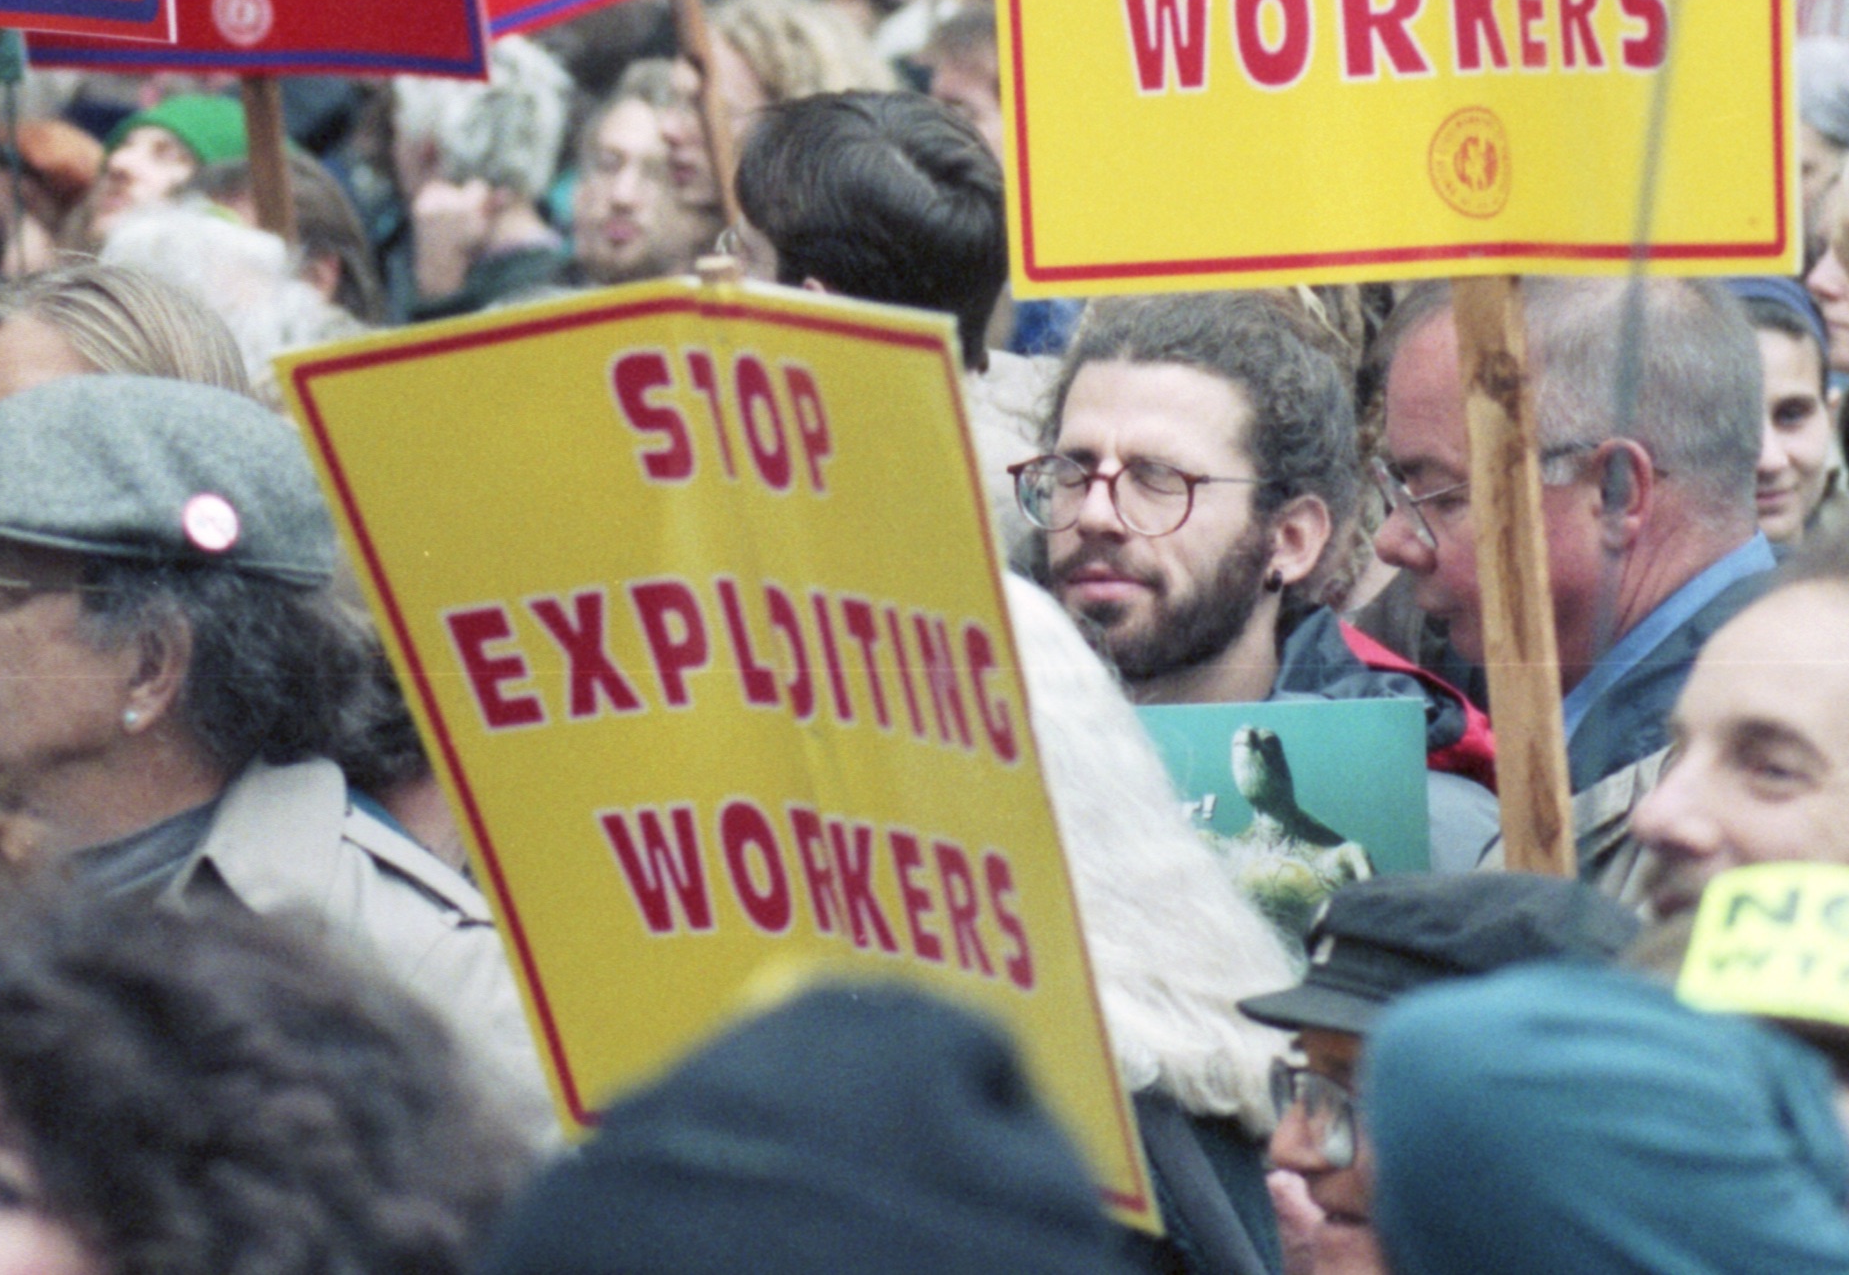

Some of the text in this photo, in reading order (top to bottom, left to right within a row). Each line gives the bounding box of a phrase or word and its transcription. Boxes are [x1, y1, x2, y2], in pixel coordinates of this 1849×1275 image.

[612, 351, 832, 493] STOP
[446, 579, 1018, 765] EXPLOITING
[600, 800, 1034, 989] WORKERS
